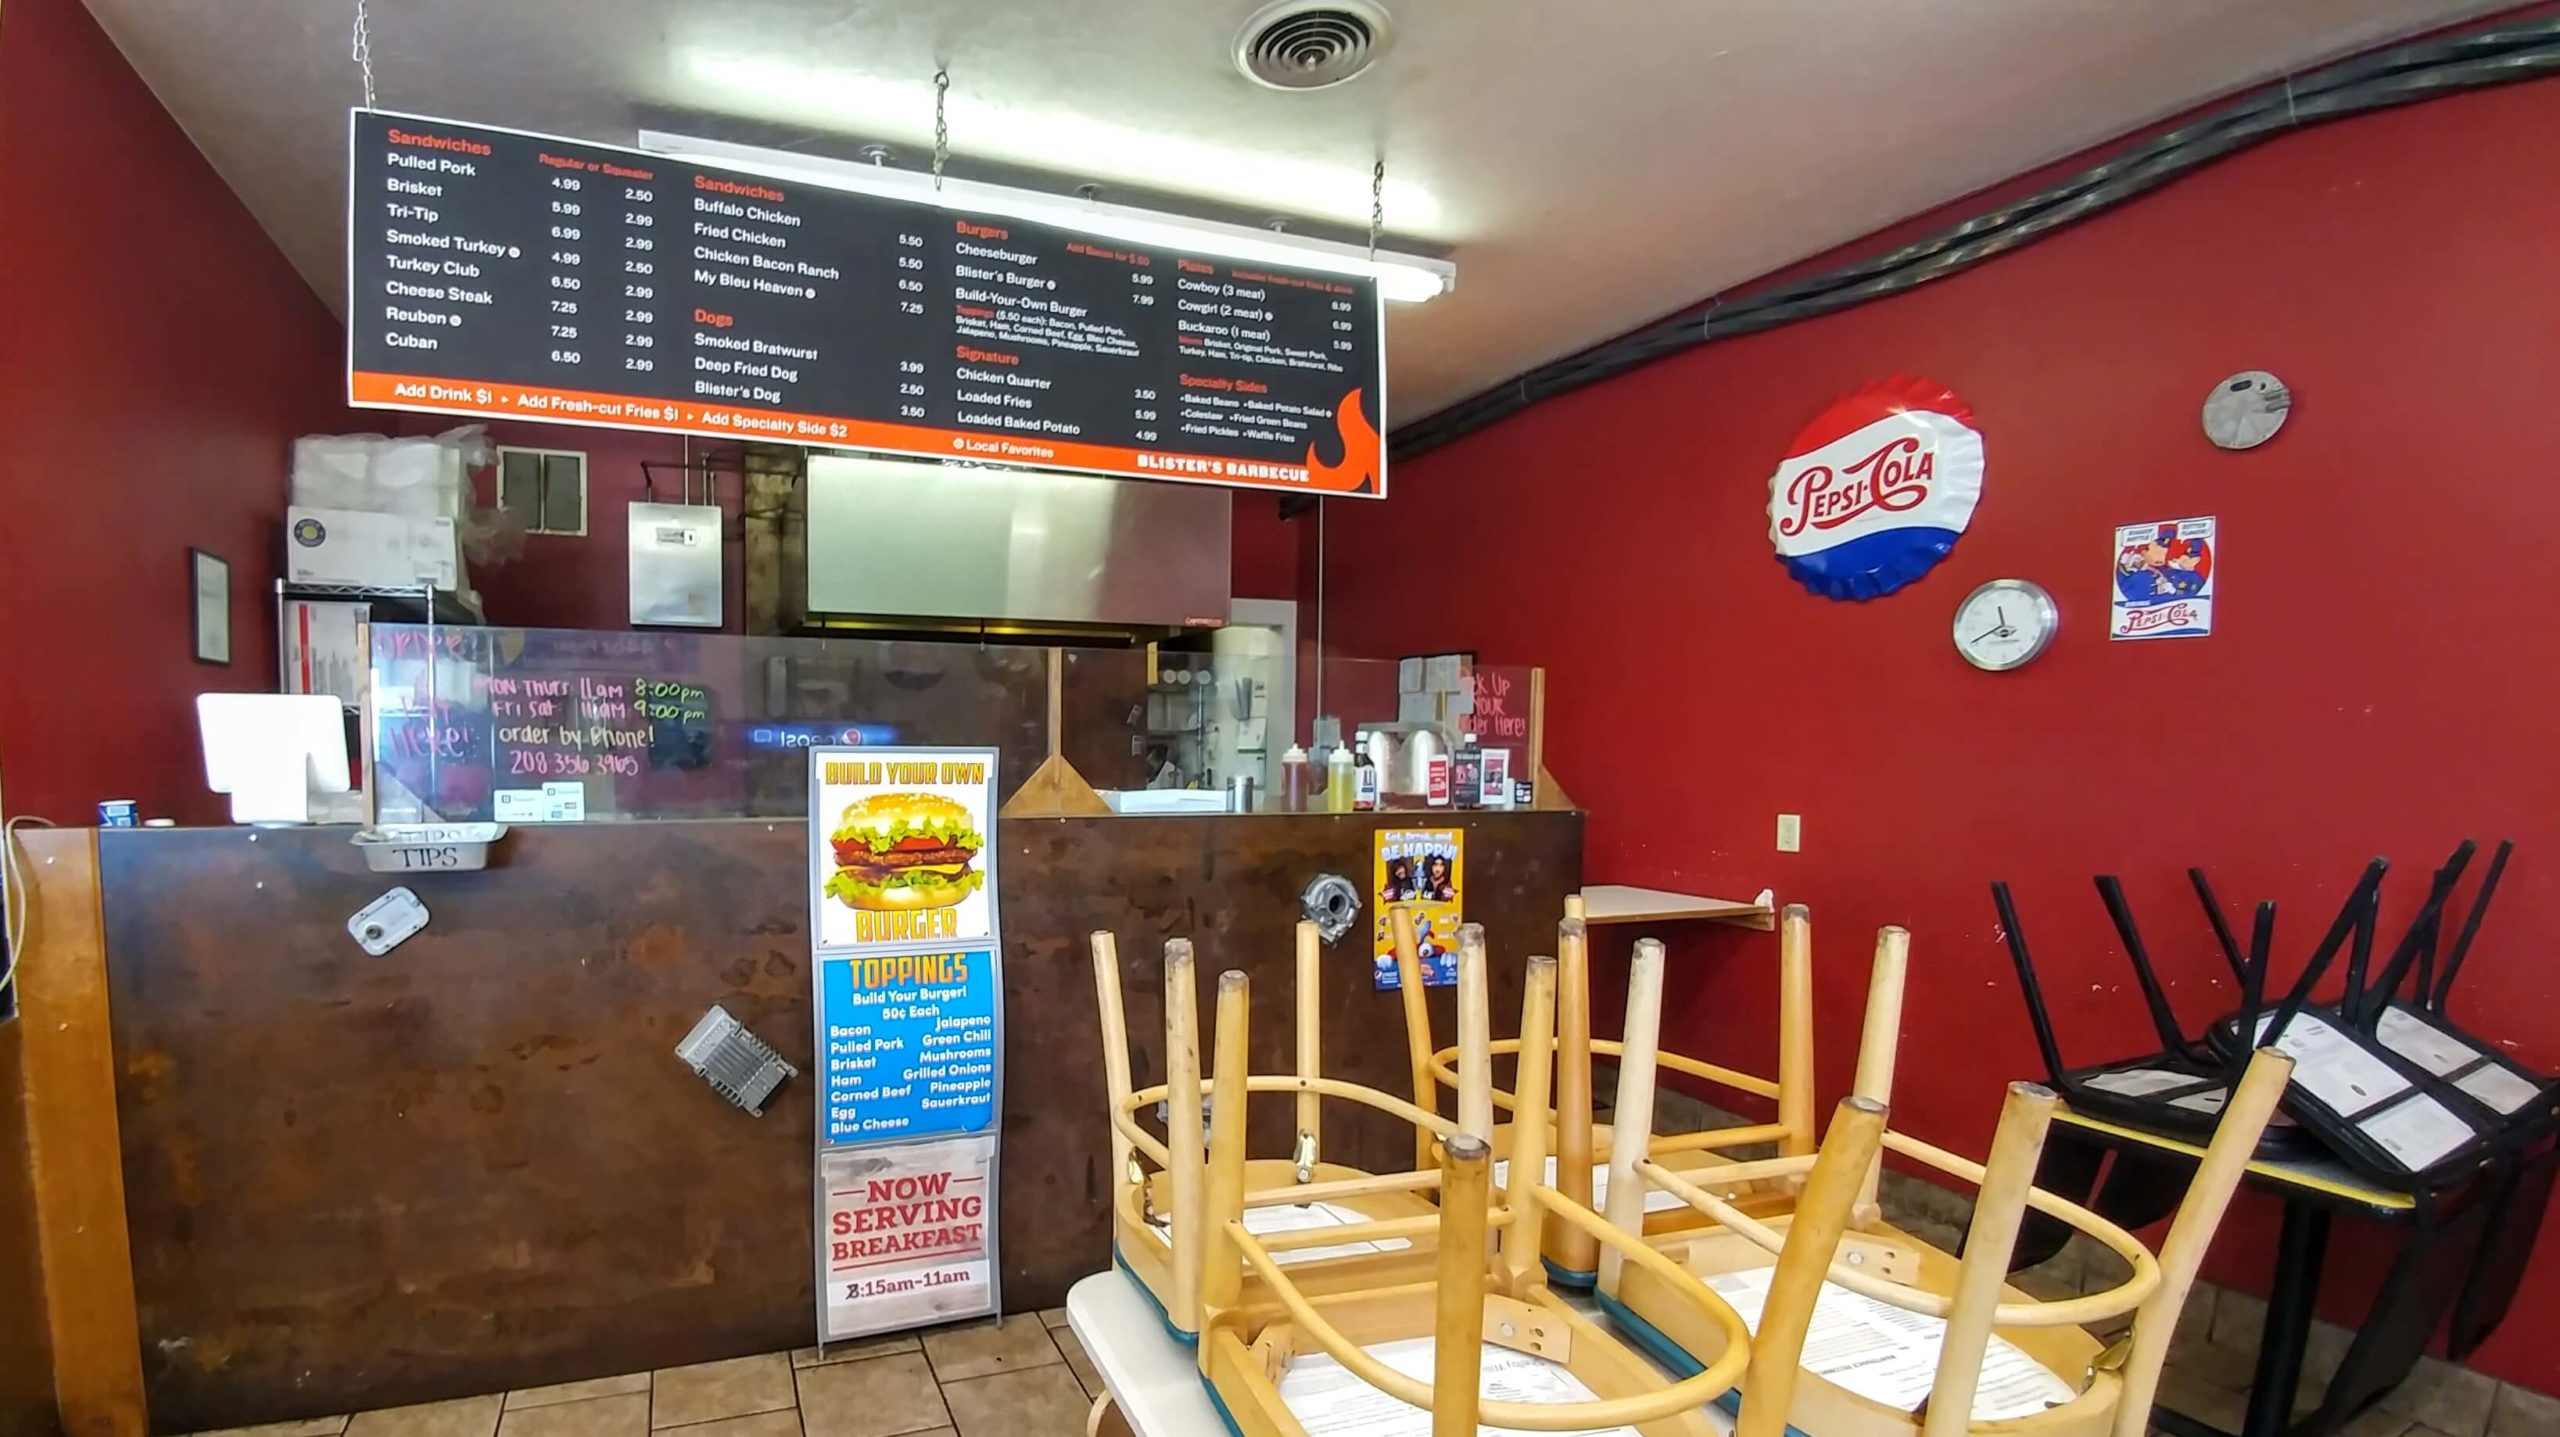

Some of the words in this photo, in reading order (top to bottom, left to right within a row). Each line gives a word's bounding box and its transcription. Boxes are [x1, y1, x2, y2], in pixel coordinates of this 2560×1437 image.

[388, 129, 491, 155] Sandwiches
[387, 153, 436, 171] Pulled
[440, 160, 476, 176] Pork
[387, 179, 442, 196] Brisket
[552, 178, 580, 191] 4.99
[694, 175, 784, 201] Sandwiches
[625, 188, 652, 202] 2.50
[387, 204, 438, 223] Tri-Tip
[551, 202, 580, 215] 5.99
[694, 198, 744, 218] Buffalo
[747, 206, 800, 226] Chicken
[625, 213, 652, 226] 2.99
[551, 227, 580, 240] 6.99
[694, 223, 728, 238] Fried
[732, 228, 786, 248] Chicken
[957, 221, 1008, 240] Burgers
[387, 230, 449, 248] Smoked
[454, 236, 505, 257] Turkey
[625, 238, 652, 251] 2.99
[899, 234, 923, 247] 5.50
[551, 252, 580, 265] 4.99
[956, 243, 1038, 265] Cheeseburger
[387, 256, 440, 274] Turkey
[444, 261, 480, 277] Club
[625, 261, 652, 274] 2.50
[694, 247, 750, 265] Chicken
[753, 256, 794, 272] Bacon
[798, 264, 839, 280] Ranch
[899, 258, 923, 270] 5.50
[551, 277, 580, 290] 6.50
[694, 270, 716, 286] My
[720, 273, 750, 290] Bleu
[754, 279, 802, 297] Heaven
[956, 265, 1003, 282] Blister's
[1006, 272, 1045, 289] Burger
[386, 281, 444, 299] Cheese
[449, 288, 493, 304] Steak
[625, 286, 652, 299] 2.99
[1177, 279, 1220, 296] Cowboy
[1223, 283, 1234, 297] (3
[1236, 287, 1265, 301] meat)
[551, 301, 577, 314] 7.25
[900, 302, 924, 314] 7.25
[956, 288, 1047, 312] Build-Your-Own
[1050, 301, 1087, 318] Burger
[1133, 295, 1153, 306] 7.99
[386, 307, 446, 325] Reuben
[625, 311, 653, 323] 2.99
[694, 310, 733, 327] Dogs
[1178, 300, 1217, 315] Cowgirl
[1220, 304, 1231, 316] (2
[1234, 308, 1263, 321] meat)
[551, 326, 577, 339] 7.25
[1178, 321, 1228, 336] Buckaroo
[1241, 327, 1271, 341] meat)
[385, 333, 438, 350] Cuban
[625, 335, 653, 347] 2.99
[695, 333, 750, 351] Smoked
[753, 341, 818, 360] Bratwurst
[551, 351, 580, 364] 6.50
[956, 346, 1019, 365] Signature
[625, 359, 653, 372] 2.99
[695, 357, 731, 374] Deep
[734, 362, 768, 377] Fried
[771, 366, 798, 382] Dog
[900, 362, 924, 374] 3.99
[957, 368, 1004, 384] Chicken
[1007, 374, 1051, 389] Quarter
[1179, 374, 1232, 392] Specialty
[1235, 381, 1268, 394] Sides
[395, 383, 426, 398] Add
[430, 386, 472, 402] Drink
[695, 381, 750, 398] Blister's
[754, 387, 780, 403] Dog
[900, 384, 924, 396] 2.50
[518, 394, 548, 408] Add
[551, 397, 622, 415] Fresh-cut
[625, 403, 660, 418] Fries
[957, 390, 1001, 405] Loaded
[1003, 395, 1032, 409] Fries
[1213, 397, 1239, 408] Beans
[901, 406, 925, 418] 3.50
[1276, 403, 1301, 415] Potato
[1303, 406, 1325, 417] Salad
[702, 411, 730, 425] Add
[733, 414, 794, 433] Specialty
[798, 420, 826, 435] Side
[830, 424, 847, 438] $2
[958, 411, 1002, 427] Loaded
[1005, 417, 1041, 431] Baked
[1043, 421, 1080, 435] Potato
[1257, 416, 1280, 428] Green
[1283, 419, 1307, 430] Beans
[1136, 431, 1157, 442] 4.99
[1209, 426, 1239, 438] Pickles
[1275, 431, 1295, 443] Fries
[966, 441, 999, 452] Local
[1002, 444, 1054, 459] Favorites
[1137, 454, 1222, 474] BLISTER'S
[1226, 463, 1309, 482] BARBECUE
[559, 724, 583, 750] by
[510, 750, 548, 774] 208
[826, 762, 882, 785] BUILD
[886, 762, 938, 785] YOUR
[941, 763, 984, 784] OWN
[393, 848, 457, 867] TIPS
[856, 908, 958, 943] BURGER
[850, 953, 968, 989] TOPPINGS
[853, 991, 885, 1005] Build
[888, 991, 916, 1002] Your
[920, 986, 967, 1001] Burger!
[909, 1005, 940, 1017] Each
[830, 1026, 871, 1037] Bacon
[922, 1034, 960, 1046] Green
[831, 1041, 871, 1054] Pulled
[875, 1038, 904, 1050] Pork
[831, 1057, 876, 1071] Brisket
[919, 1048, 991, 1063] Mushrooms
[903, 1066, 945, 1080] Grilled
[949, 1064, 991, 1075] Onions
[831, 1076, 861, 1087] Ham
[930, 1079, 991, 1093] Pineapple
[831, 1088, 878, 1103] Corned
[882, 1085, 911, 1098] Beef
[922, 1093, 991, 1109] Sauerkraut
[831, 1107, 856, 1120] Egg
[831, 1123, 860, 1134] Blue
[863, 1117, 909, 1130] Cheese
[867, 1172, 951, 1203] NOW
[833, 1197, 982, 1235] SERVING
[832, 1223, 982, 1261] BREAKFAST
